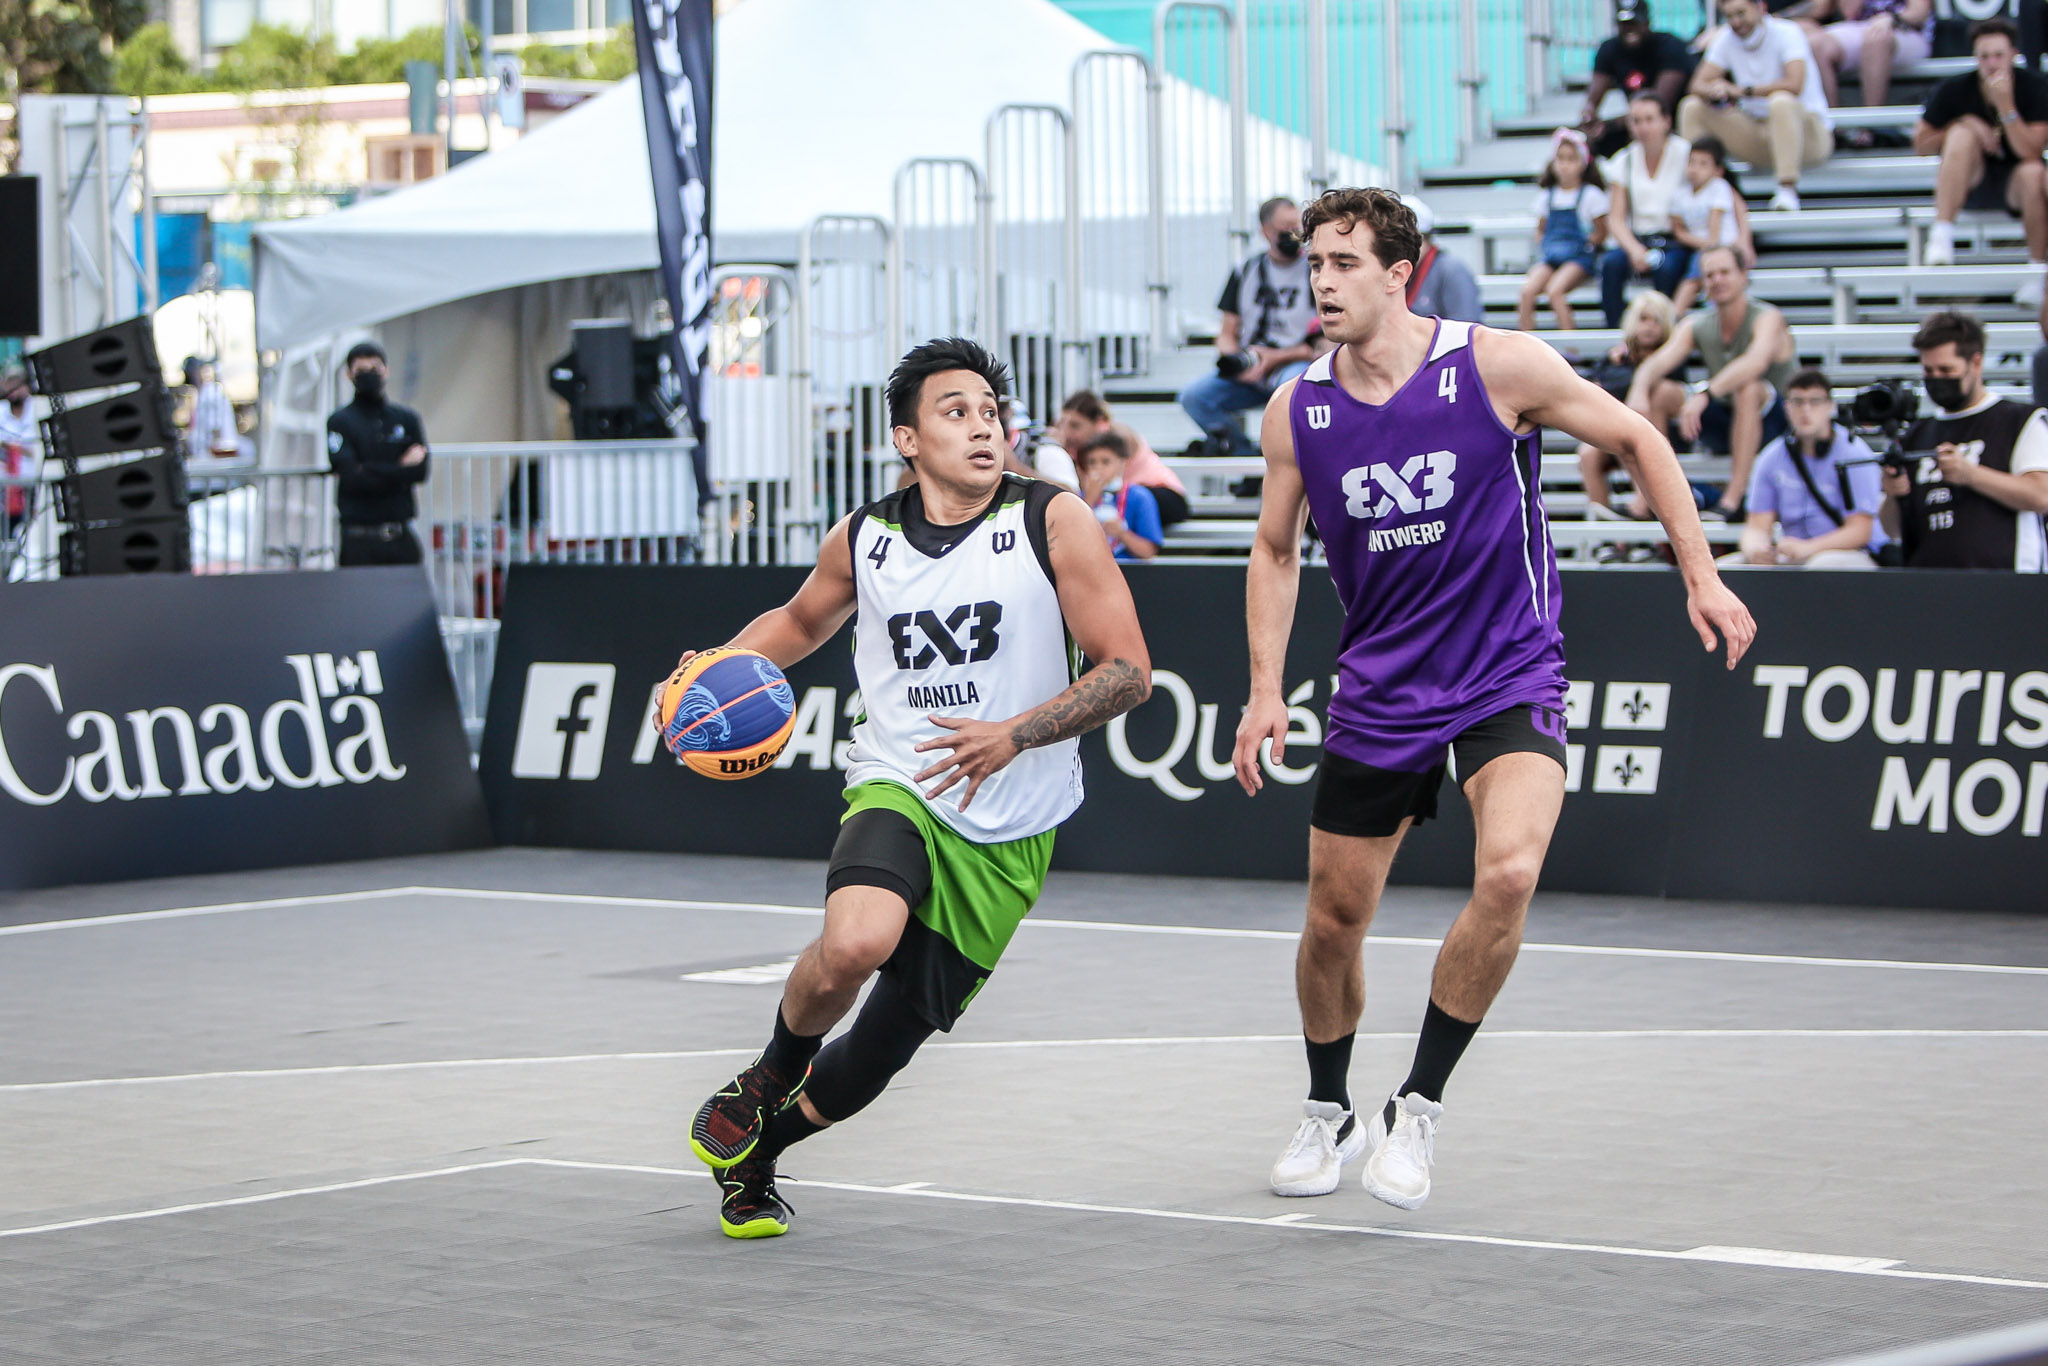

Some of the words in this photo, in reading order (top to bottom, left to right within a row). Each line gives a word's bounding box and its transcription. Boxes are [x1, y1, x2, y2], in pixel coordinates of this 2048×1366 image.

[1438, 366, 1457, 404] 4
[867, 535, 893, 570] 4
[1368, 519, 1447, 552] ANTWERP
[907, 681, 980, 709] MANILA
[0, 652, 407, 806] Canada
[1106, 669, 1339, 801] Qué
